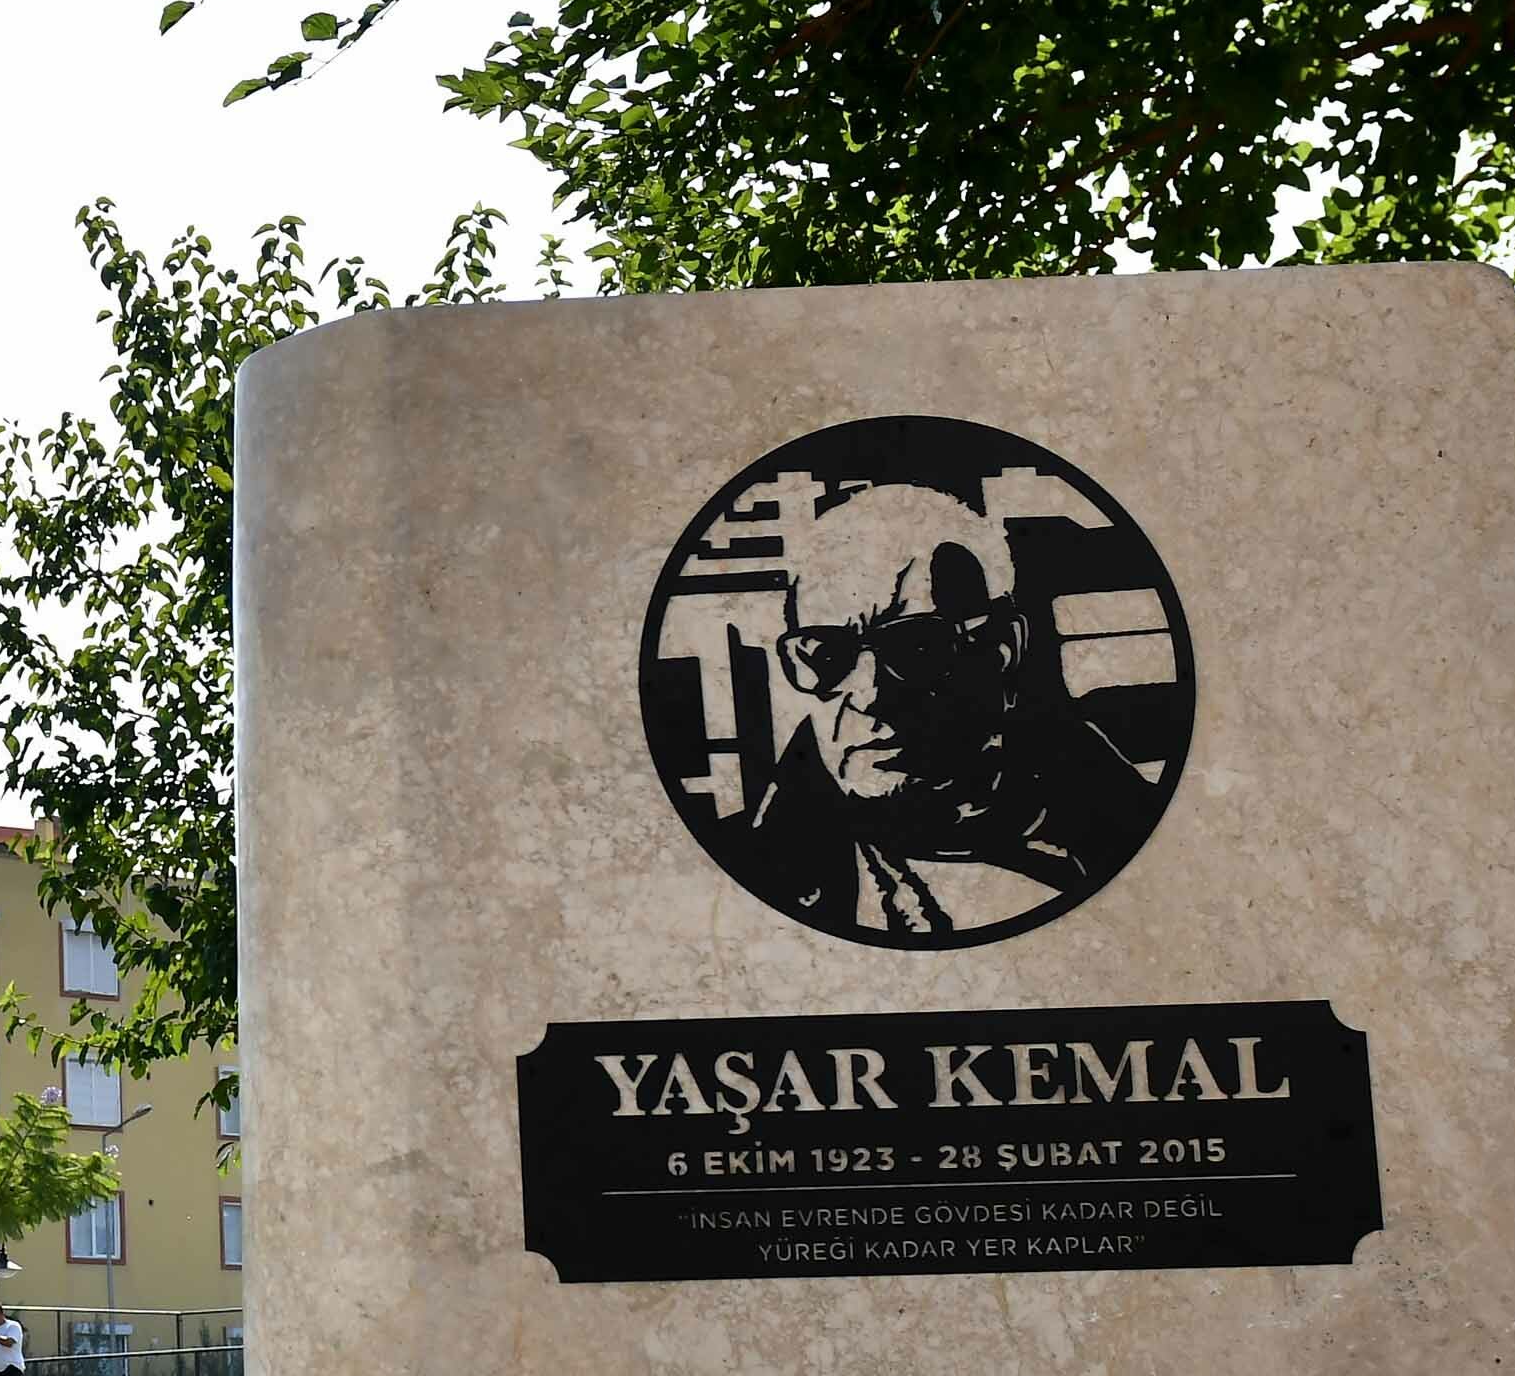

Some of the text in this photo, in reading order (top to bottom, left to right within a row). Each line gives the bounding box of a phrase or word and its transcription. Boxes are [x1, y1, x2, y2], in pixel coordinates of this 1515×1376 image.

[594, 1037, 1291, 1135] YAŞAR KEMAL
[667, 1151, 688, 1176] 6
[704, 1140, 796, 1176] EKİM
[810, 1147, 896, 1173] 1923
[938, 1145, 982, 1169] 28
[997, 1140, 1123, 1171] ŞUBAT
[1139, 1137, 1226, 1164] 2015
[781, 1207, 905, 1228] EVRENDE
[914, 1198, 1031, 1224] GÖVDESİ
[1041, 1201, 1134, 1221] KADAR
[1143, 1193, 1223, 1219] DEĞİL
[758, 1236, 855, 1262] YÜREĞİ
[865, 1239, 956, 1259] KADAR
[966, 1238, 1017, 1257] YER
